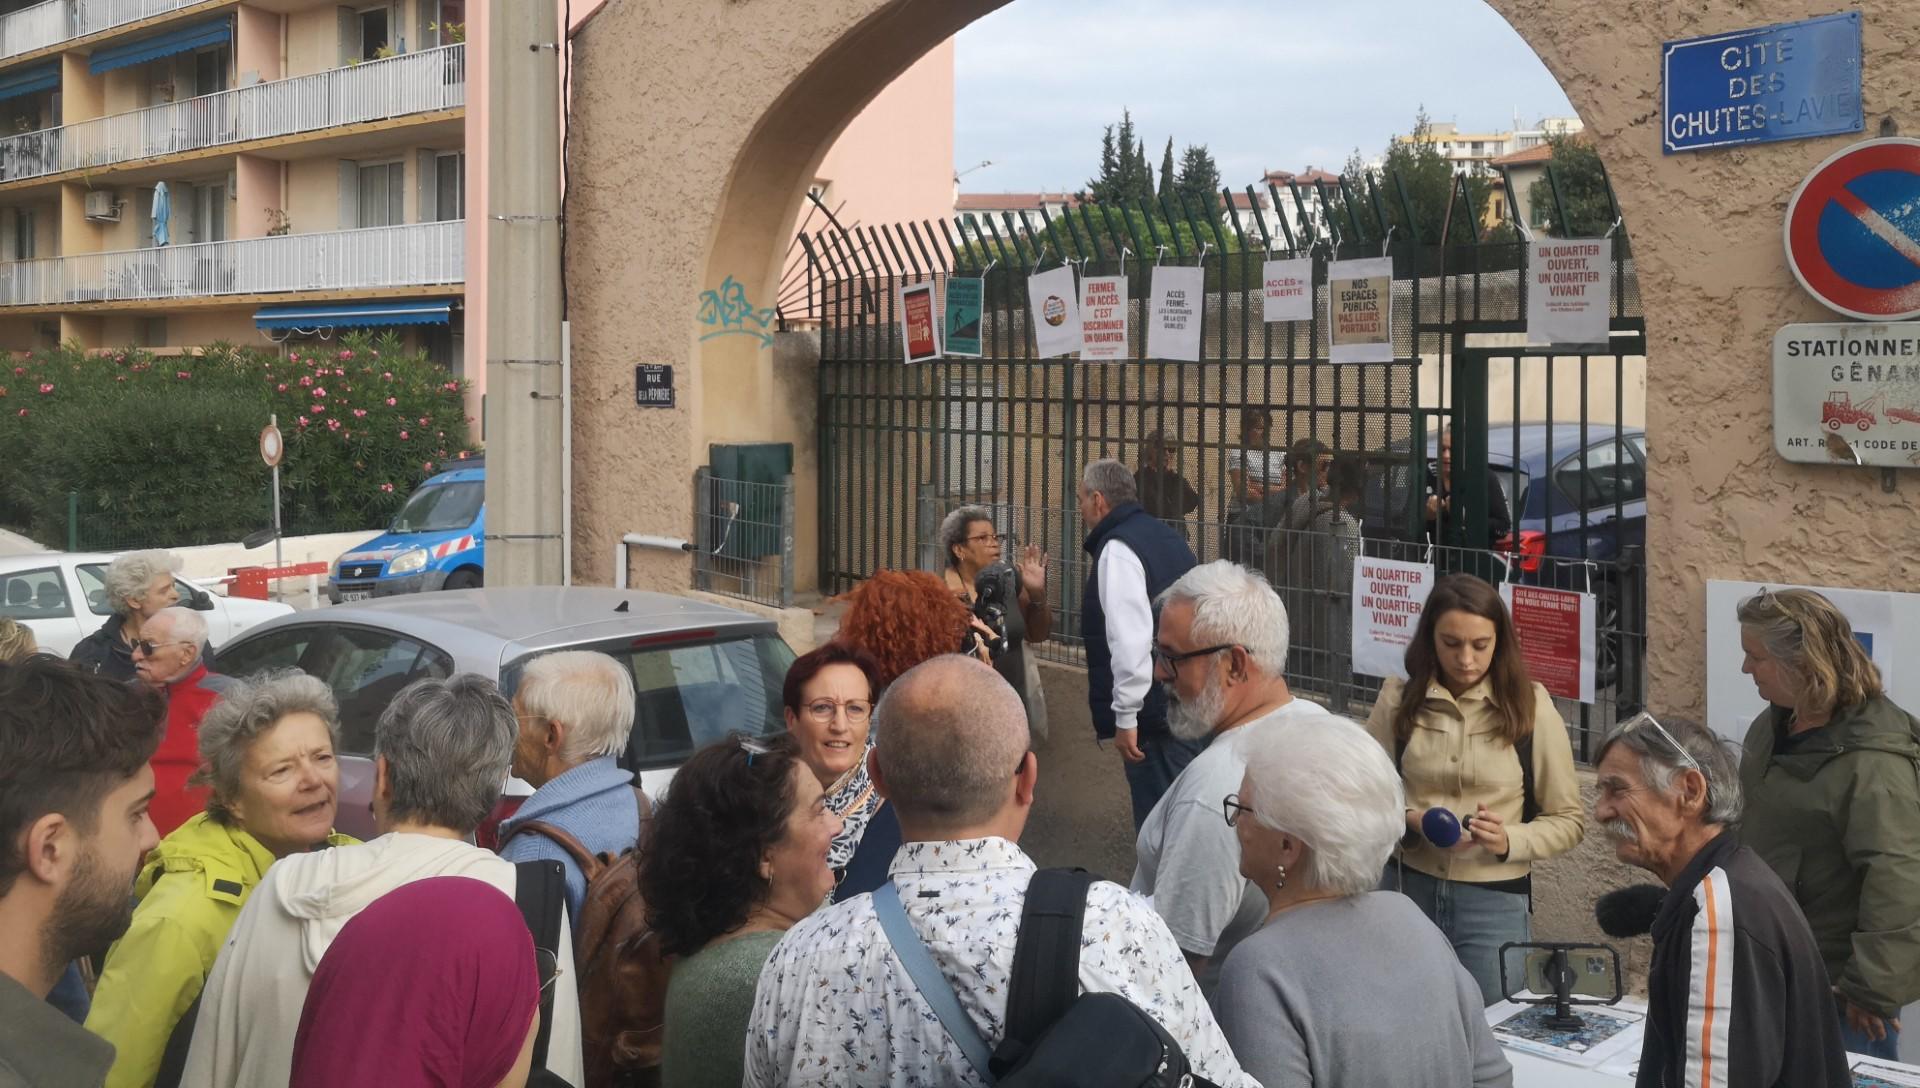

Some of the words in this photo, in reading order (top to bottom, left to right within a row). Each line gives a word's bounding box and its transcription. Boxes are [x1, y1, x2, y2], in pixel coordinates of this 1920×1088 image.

[1729, 72, 1786, 98] DES
[1671, 92, 1851, 139] CHUTES-LAVIE
[1538, 247, 1551, 257] UN
[1553, 245, 1600, 257] QUARTIER
[1547, 259, 1589, 271] OUVERT,
[1352, 279, 1368, 289] NOS
[1538, 273, 1551, 284] UN
[1553, 272, 1600, 284] QUARTIER
[1088, 282, 1115, 293] FERMER
[1549, 285, 1586, 296] VIVANT
[1341, 289, 1377, 301] ESPACES
[647, 373, 661, 383] RUE
[1787, 438, 1814, 448] ART.
[1864, 440, 1896, 450] CODE
[1902, 441, 1918, 450] DE
[1362, 566, 1374, 578] UN
[1376, 567, 1422, 584] QUARTIER
[1370, 581, 1411, 599] OUVERT,
[1361, 594, 1374, 608] UN
[1375, 597, 1421, 614] QUARTIER
[1372, 611, 1408, 627] VIVANT
